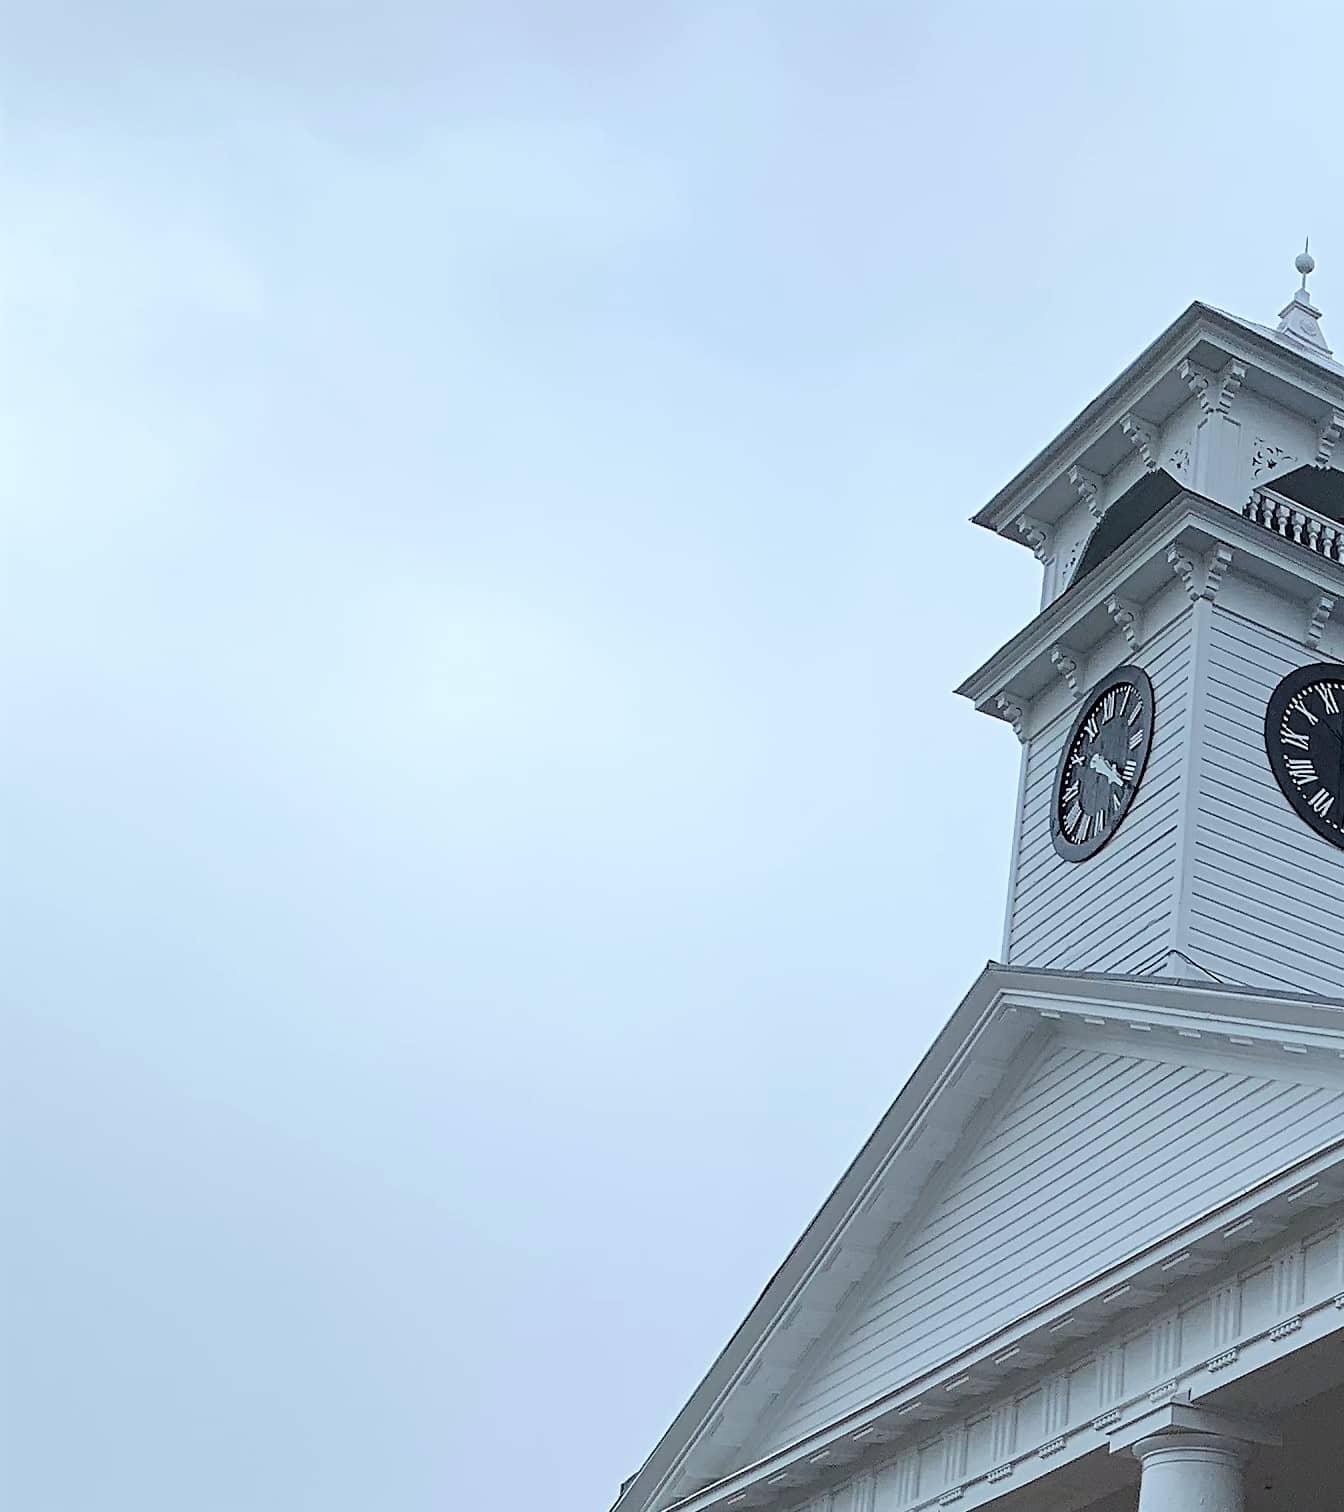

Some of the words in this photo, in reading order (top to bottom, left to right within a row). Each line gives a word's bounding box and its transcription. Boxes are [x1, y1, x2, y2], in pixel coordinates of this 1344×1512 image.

[1315, 683, 1339, 715] XI
[1294, 701, 1319, 725] X
[1129, 729, 1144, 750] III
[1281, 727, 1310, 750] IX
[1071, 754, 1085, 766] X
[1288, 759, 1319, 785] VIII
[1308, 788, 1335, 817] VII
